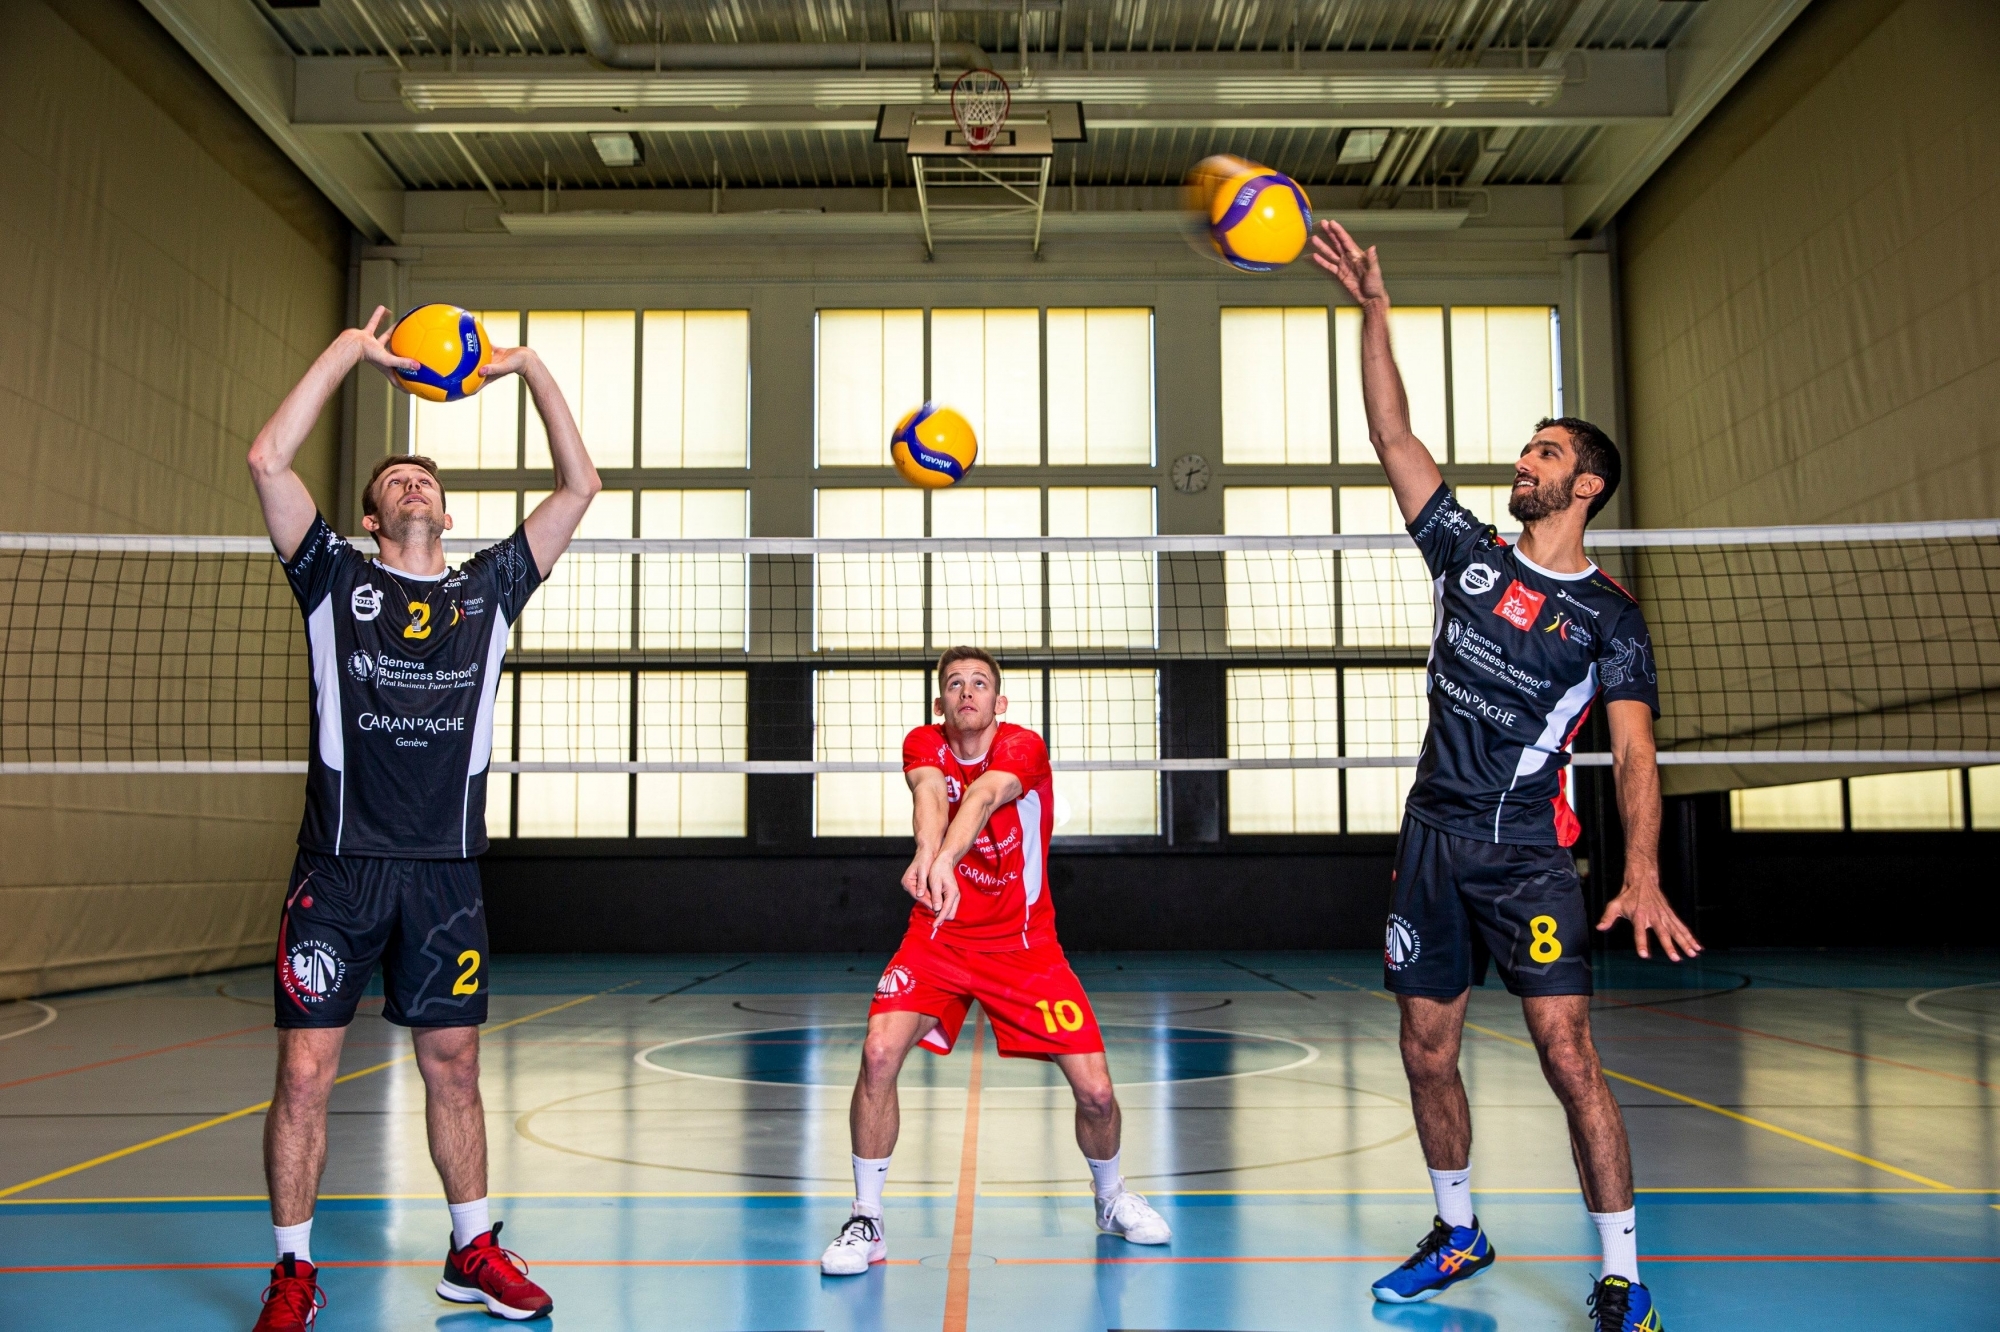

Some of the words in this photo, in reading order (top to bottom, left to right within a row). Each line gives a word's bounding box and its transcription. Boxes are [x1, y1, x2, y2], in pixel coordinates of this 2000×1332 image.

[1465, 570, 1490, 588] VOLVO
[403, 601, 431, 639] 2
[1461, 637, 1506, 669] Business
[1467, 627, 1502, 655] Geneva
[379, 655, 425, 670] Geneva
[379, 666, 433, 680] Business
[1456, 648, 1473, 661] Real
[1496, 670, 1518, 686] Future
[379, 678, 397, 687] Real
[428, 682, 453, 690] Future
[1434, 672, 1472, 704] CARAN
[1472, 694, 1517, 727] D'ACHE
[358, 712, 415, 733] CARAN
[417, 717, 465, 735] D'ACHE
[395, 737, 428, 748] Genève
[958, 863, 993, 887] CARAN
[1409, 929, 1421, 963] SCHOOL
[1529, 914, 1563, 964] 8
[282, 955, 295, 993] GENEVA
[291, 939, 337, 957] BUSINESS
[452, 949, 481, 996] 2
[303, 995, 324, 1003] GBS
[1034, 999, 1084, 1034] 10
